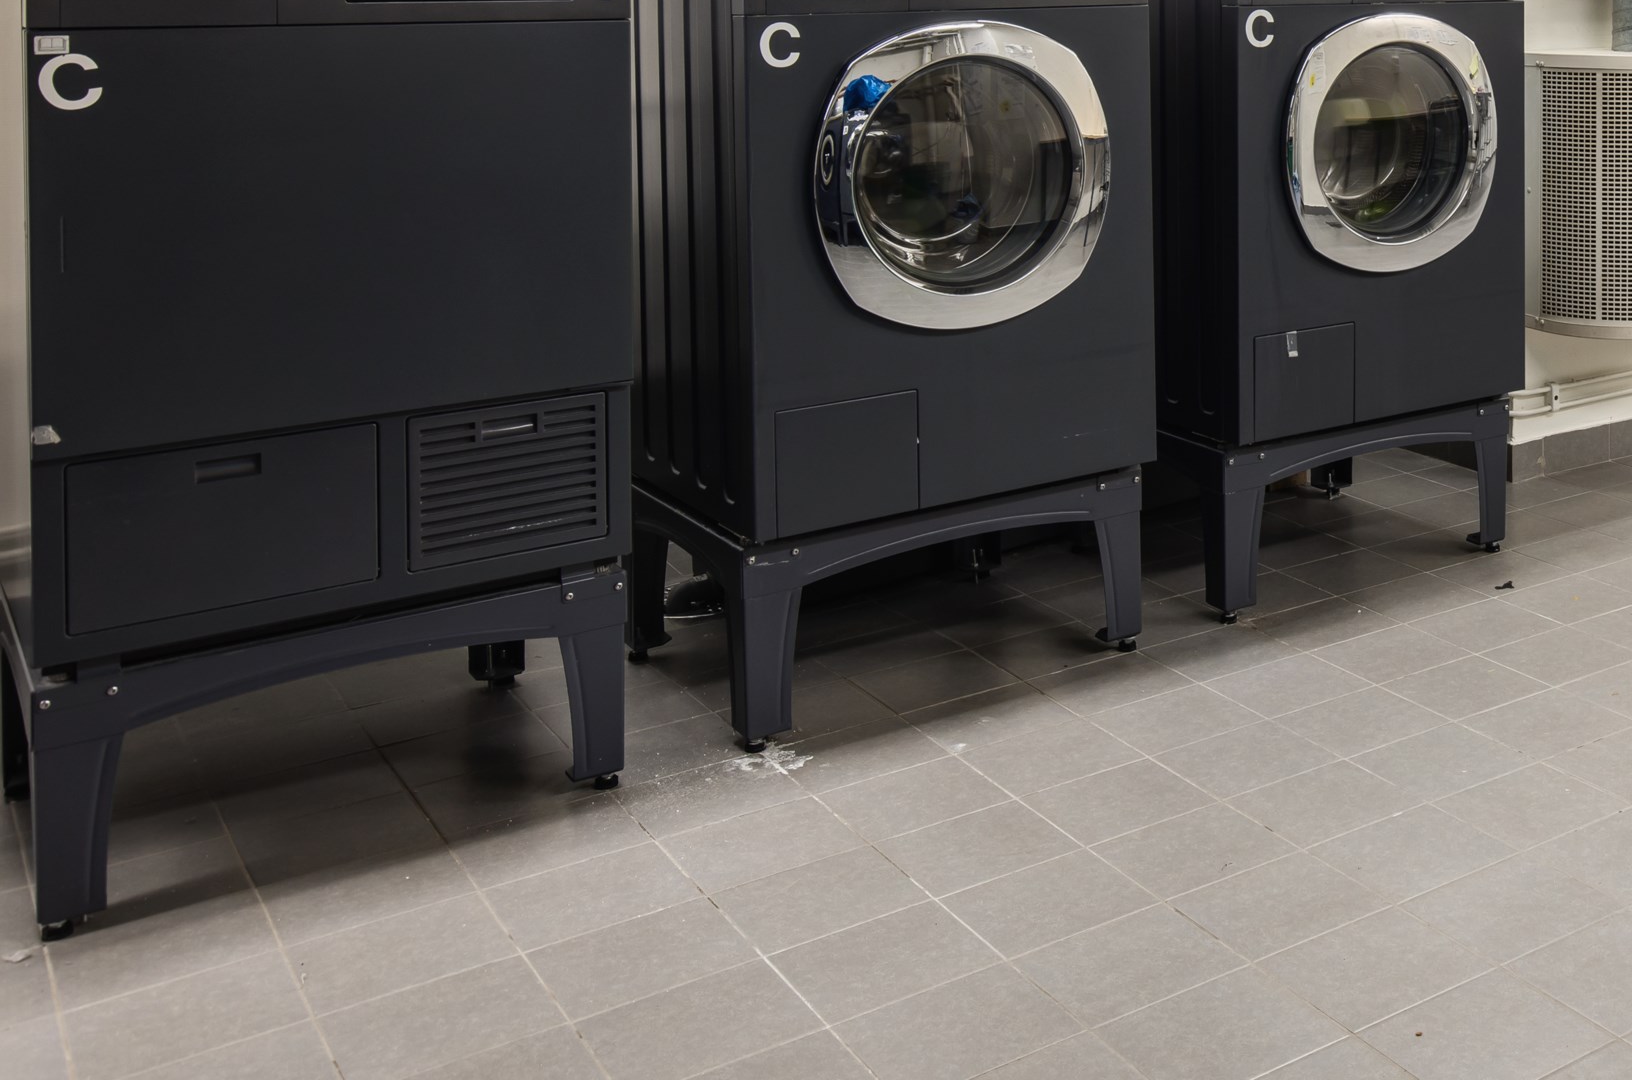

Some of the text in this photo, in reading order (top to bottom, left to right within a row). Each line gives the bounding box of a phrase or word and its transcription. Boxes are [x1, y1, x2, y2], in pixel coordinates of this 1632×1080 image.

[759, 21, 801, 68] C
[1245, 9, 1275, 48] C
[38, 53, 103, 111] C
